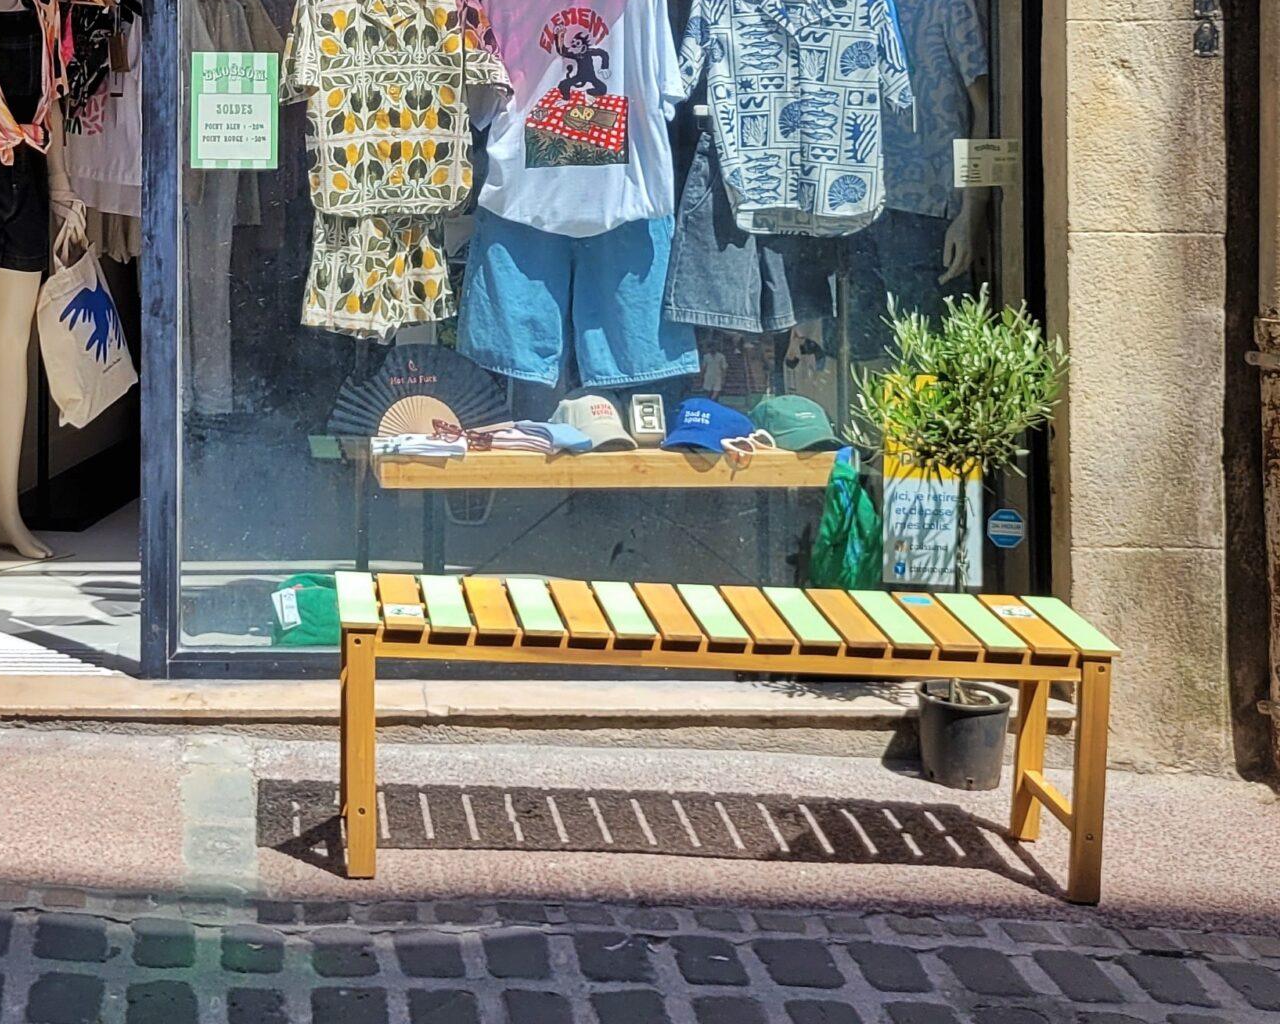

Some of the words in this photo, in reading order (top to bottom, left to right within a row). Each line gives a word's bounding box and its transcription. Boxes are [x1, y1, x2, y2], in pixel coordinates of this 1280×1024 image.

[539, 8, 610, 54] ELEMENT
[204, 64, 266, 82] BLOSSOM
[216, 103, 253, 115] SOLDES
